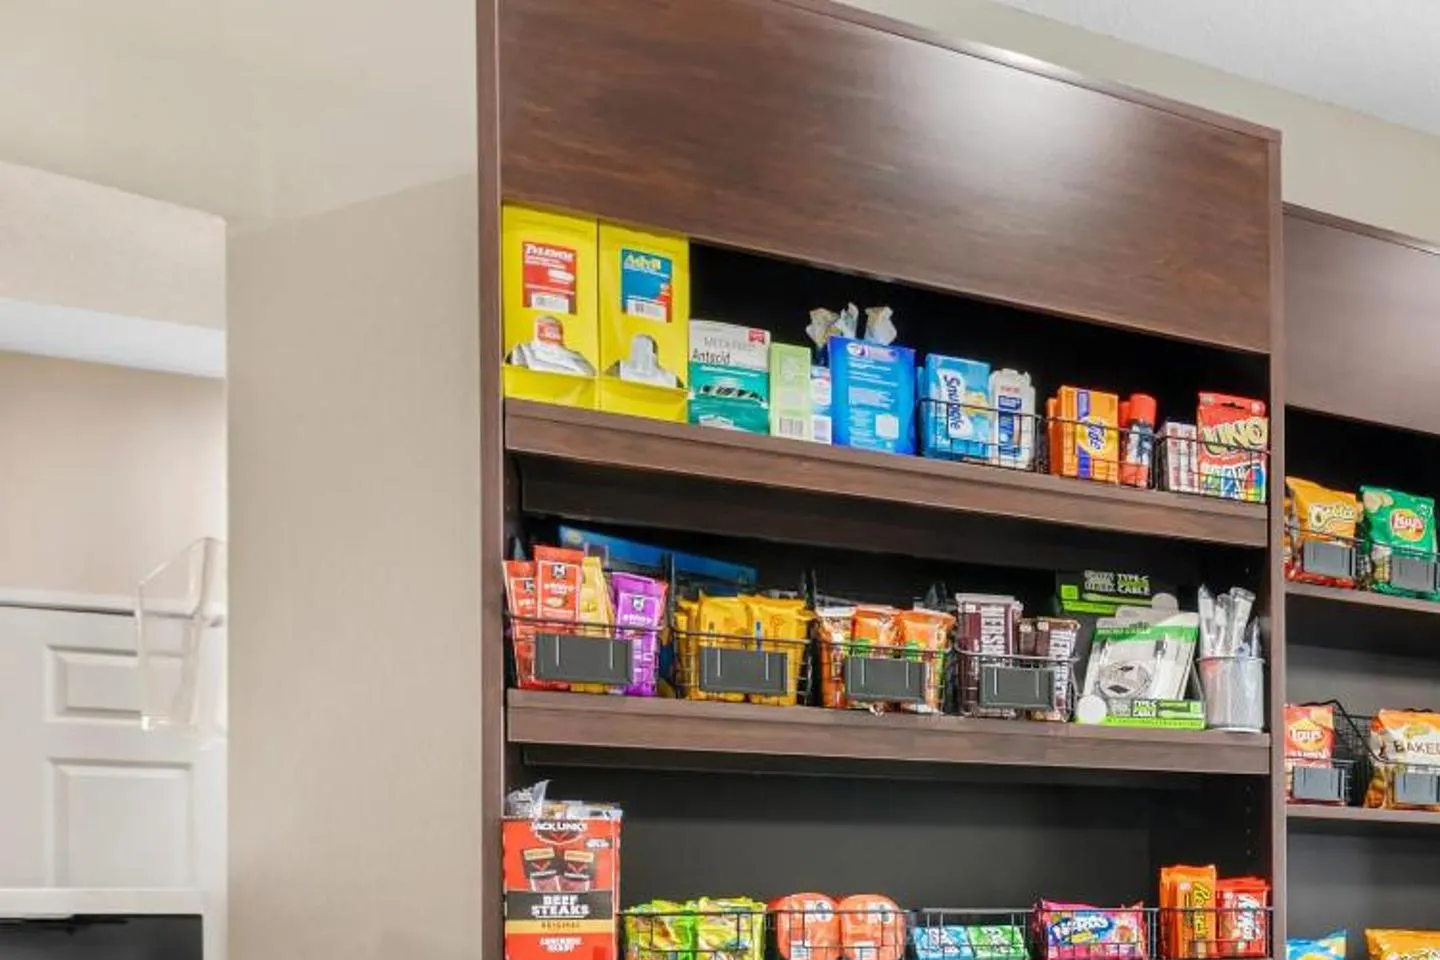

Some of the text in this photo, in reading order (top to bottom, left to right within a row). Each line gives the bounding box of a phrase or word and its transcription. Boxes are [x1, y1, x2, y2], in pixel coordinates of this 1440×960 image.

[625, 253, 662, 271] Advil
[542, 894, 579, 905] BEEF
[530, 904, 590, 916] STEAKS
